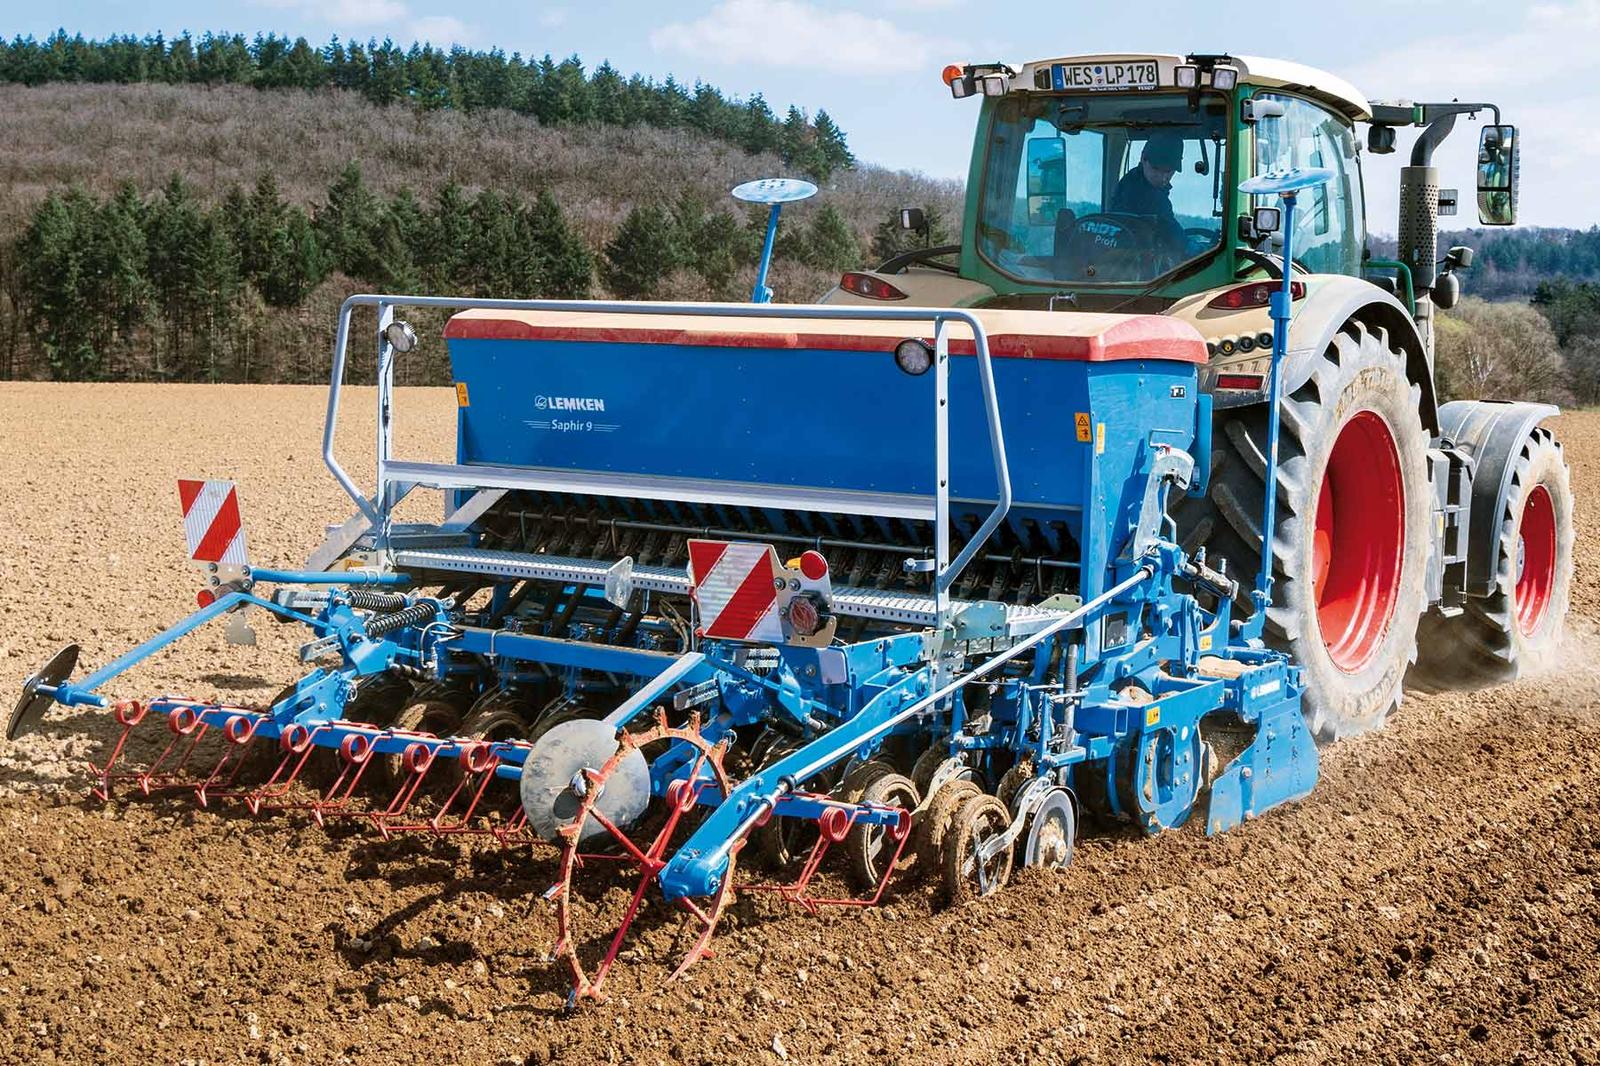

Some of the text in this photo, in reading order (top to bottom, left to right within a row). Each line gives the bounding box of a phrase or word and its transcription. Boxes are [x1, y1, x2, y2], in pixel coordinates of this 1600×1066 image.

[1063, 64, 1155, 86] WES LP 178
[548, 396, 605, 412] LEMKEN
[551, 419, 593, 432] Saphir 9
